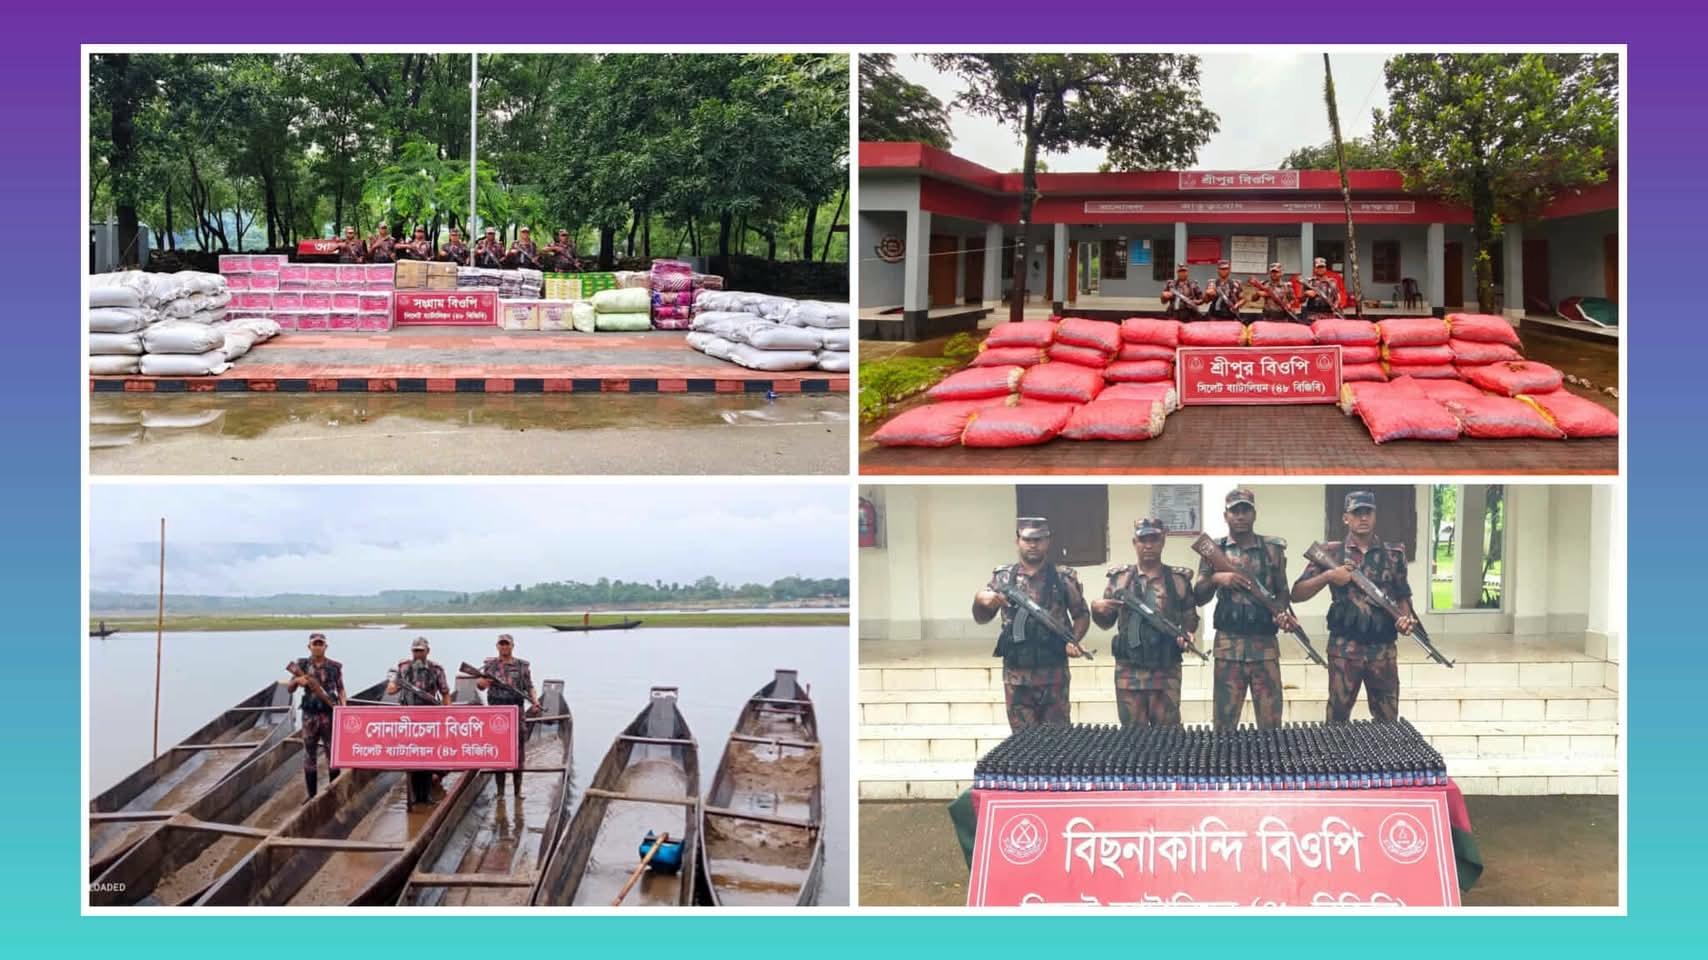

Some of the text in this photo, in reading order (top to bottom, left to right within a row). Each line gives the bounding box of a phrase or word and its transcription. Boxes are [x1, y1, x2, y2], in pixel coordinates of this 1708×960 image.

[448, 296, 478, 309] বিওপি
[1210, 356, 1310, 379] শ্রীপুর বিওপি
[1197, 381, 1326, 395] সিলেট ব্যাটালিয়ন (৪৮ বিজিবি)
[365, 715, 485, 739] সোনালীচেলা বিওপি
[352, 743, 499, 759] সিলেট ব্যাটালিয়ন (৪৮ বিজিবি)
[1062, 815, 1365, 878] বিছনাকান্দি বিওপি
